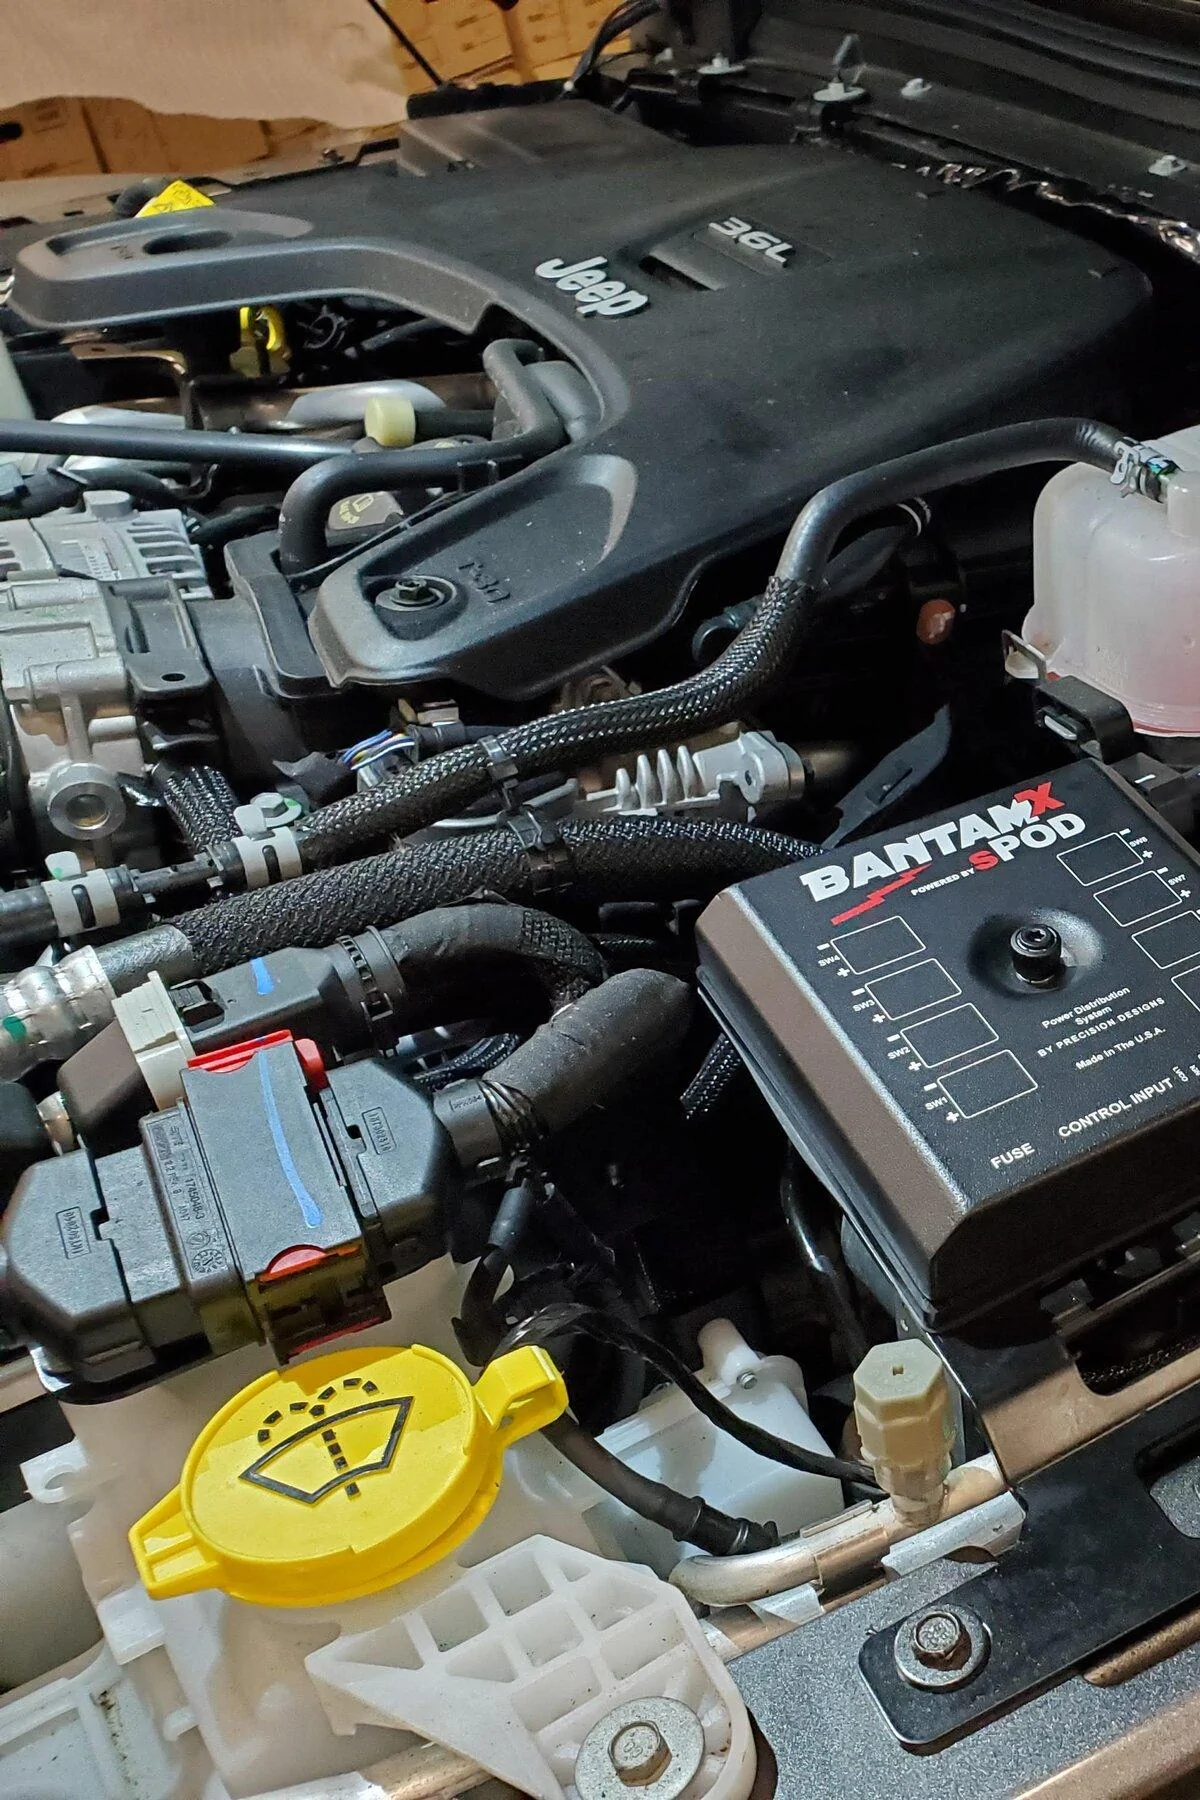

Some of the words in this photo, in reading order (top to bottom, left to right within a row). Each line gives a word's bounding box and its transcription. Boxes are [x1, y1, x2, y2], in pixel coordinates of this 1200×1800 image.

[535, 256, 648, 316] Jeep
[911, 873, 960, 896] POWERED
[960, 867, 975, 878] BY
[968, 813, 1086, 871] SPOD
[1168, 874, 1187, 886] SW7
[818, 954, 840, 967] SW4
[852, 999, 876, 1012] SW3
[1041, 1011, 1074, 1029] Power
[1073, 987, 1131, 1015] Distribution
[1074, 1006, 1113, 1026] System
[1037, 1044, 1053, 1058] BY
[1056, 1018, 1116, 1049] PRECISION
[1117, 997, 1165, 1022] DESIGNS
[887, 1046, 911, 1059] SW2
[1075, 1053, 1105, 1070] Made
[1114, 1040, 1135, 1052] The
[1134, 1026, 1166, 1042] U.S.A.
[1172, 1066, 1189, 1082] LVCO
[925, 1096, 948, 1110] SW1
[1058, 1099, 1132, 1137] CONTROL
[1129, 1077, 1174, 1104] INPUT
[990, 1142, 1035, 1169] FUSE
